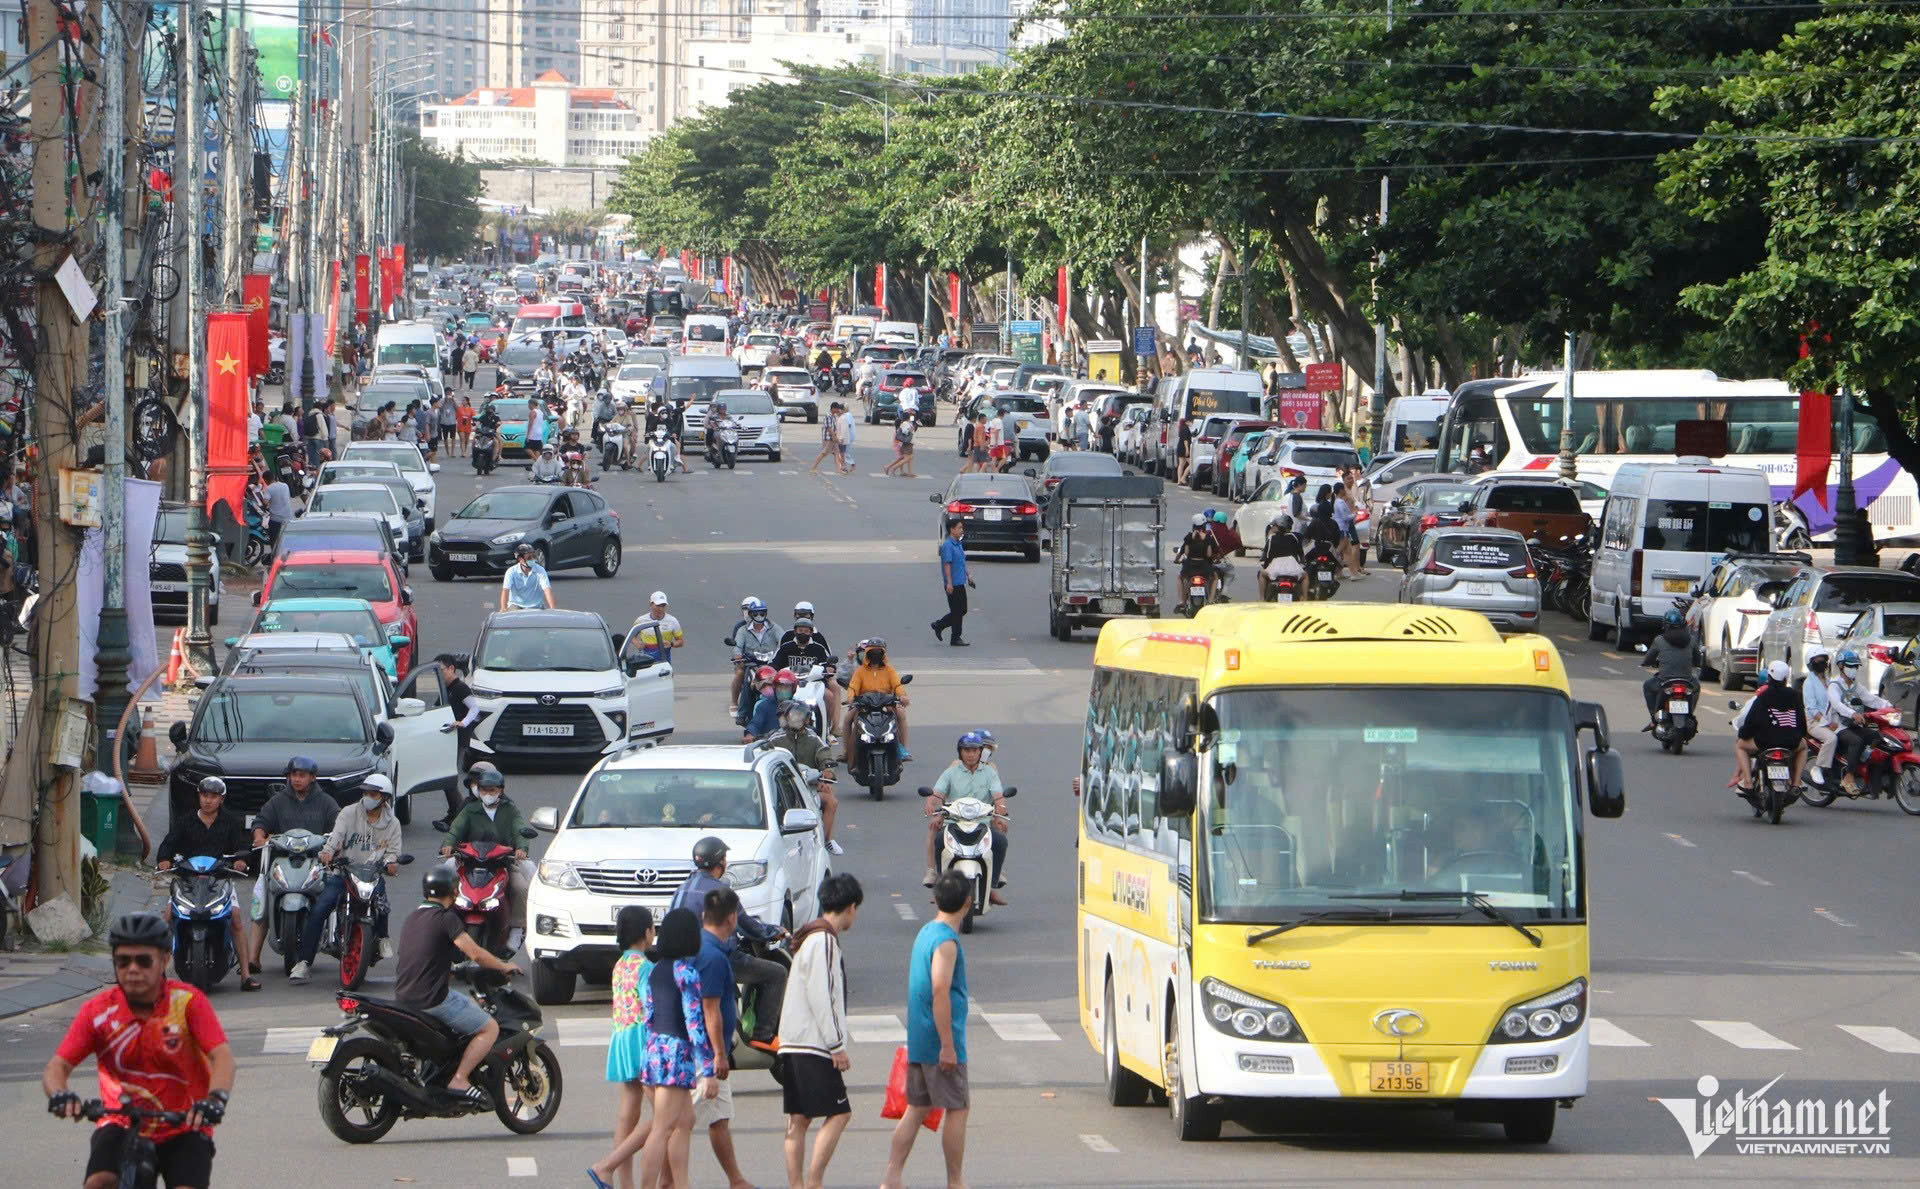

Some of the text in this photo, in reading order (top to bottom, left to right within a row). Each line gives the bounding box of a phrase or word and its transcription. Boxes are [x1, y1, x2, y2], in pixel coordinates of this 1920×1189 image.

[527, 726, 569, 735] 71A-163.37
[1252, 959, 1311, 970] THACO
[1488, 960, 1538, 971] TOWN
[1387, 1063, 1412, 1076] 51B
[1377, 1077, 1423, 1089] 213.56
